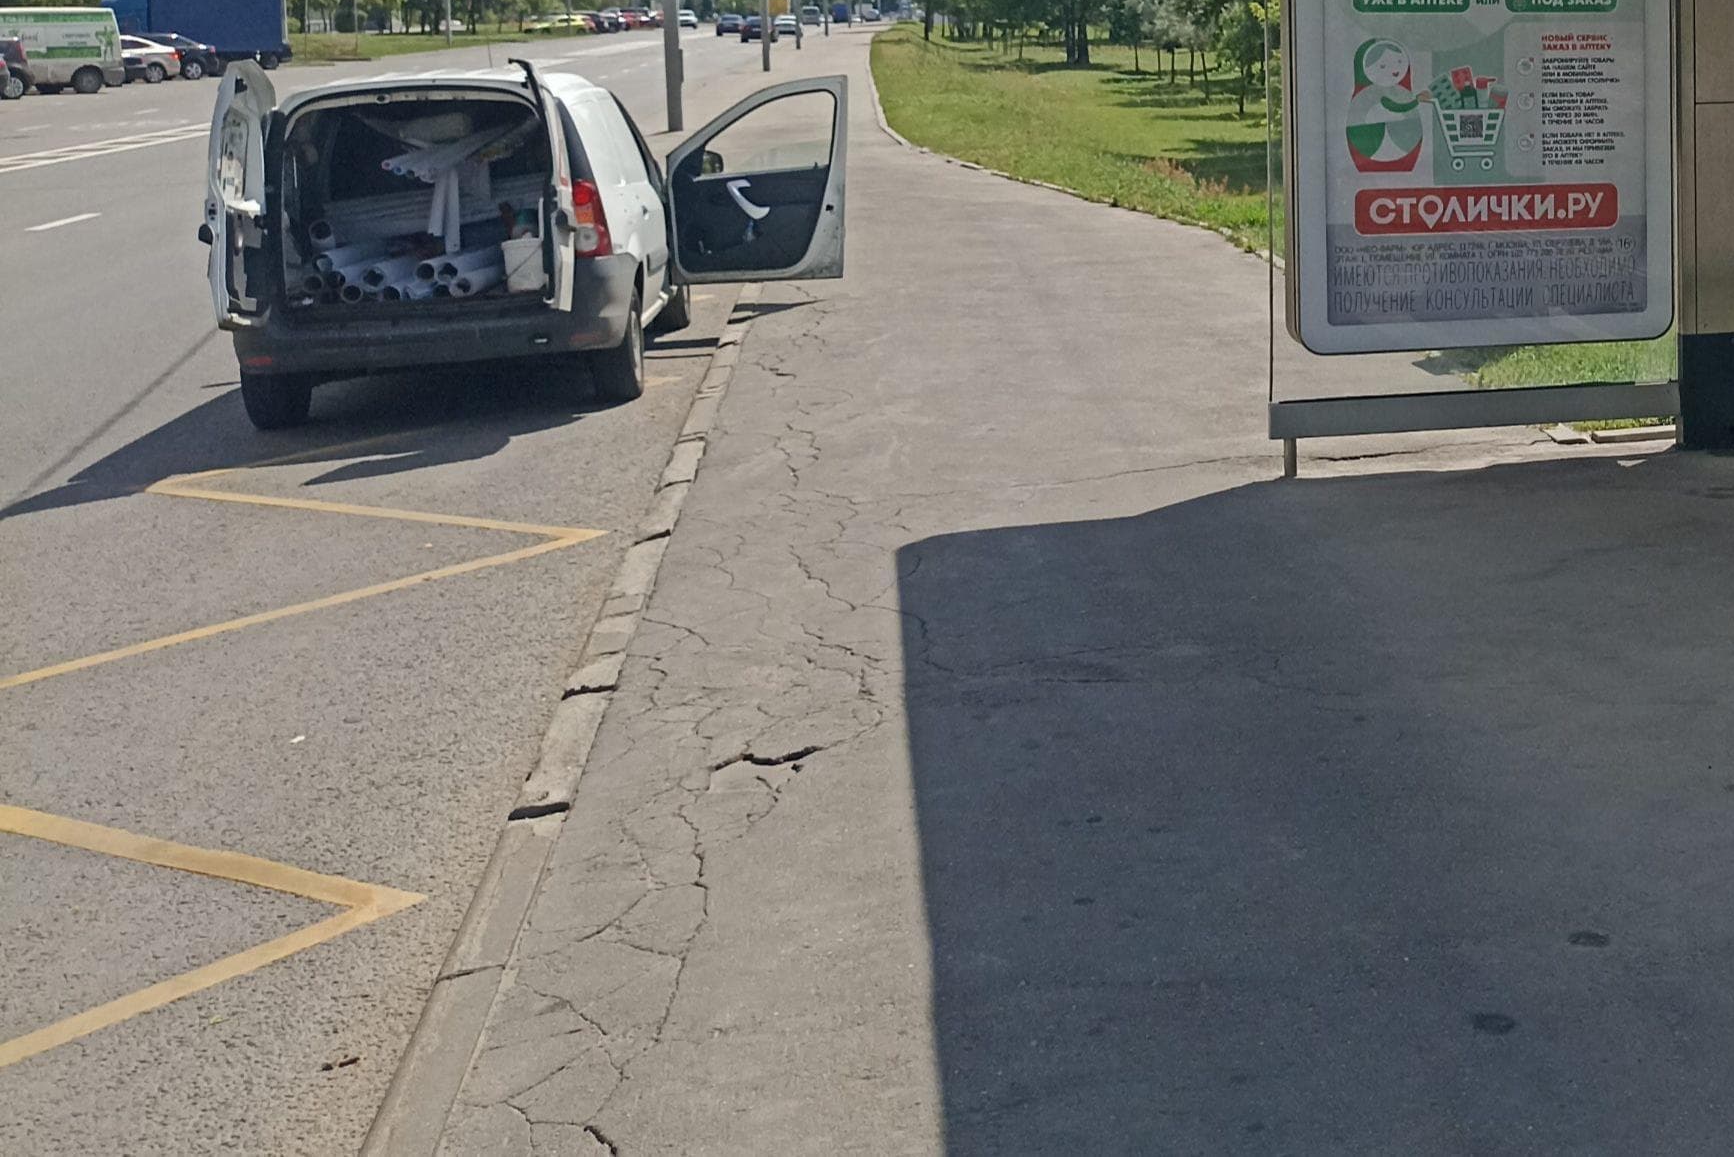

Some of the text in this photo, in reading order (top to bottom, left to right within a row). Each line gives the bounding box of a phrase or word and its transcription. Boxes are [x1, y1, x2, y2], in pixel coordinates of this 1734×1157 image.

[1541, 33, 1574, 42] НОВЫЙ
[1542, 43, 1569, 51] ЗАКАЗ
[1369, 192, 1604, 229] СТОЛИЧКИ.РУ
[1334, 262, 1400, 287] ИМЕЮТСЯ
[1549, 255, 1636, 280] НЕОБХОДИМО
[1334, 281, 1634, 314] ПОЛУЧЕНИЕ КОНСУЛЬТАЦИИ СПЕЦИАЛИСТА
